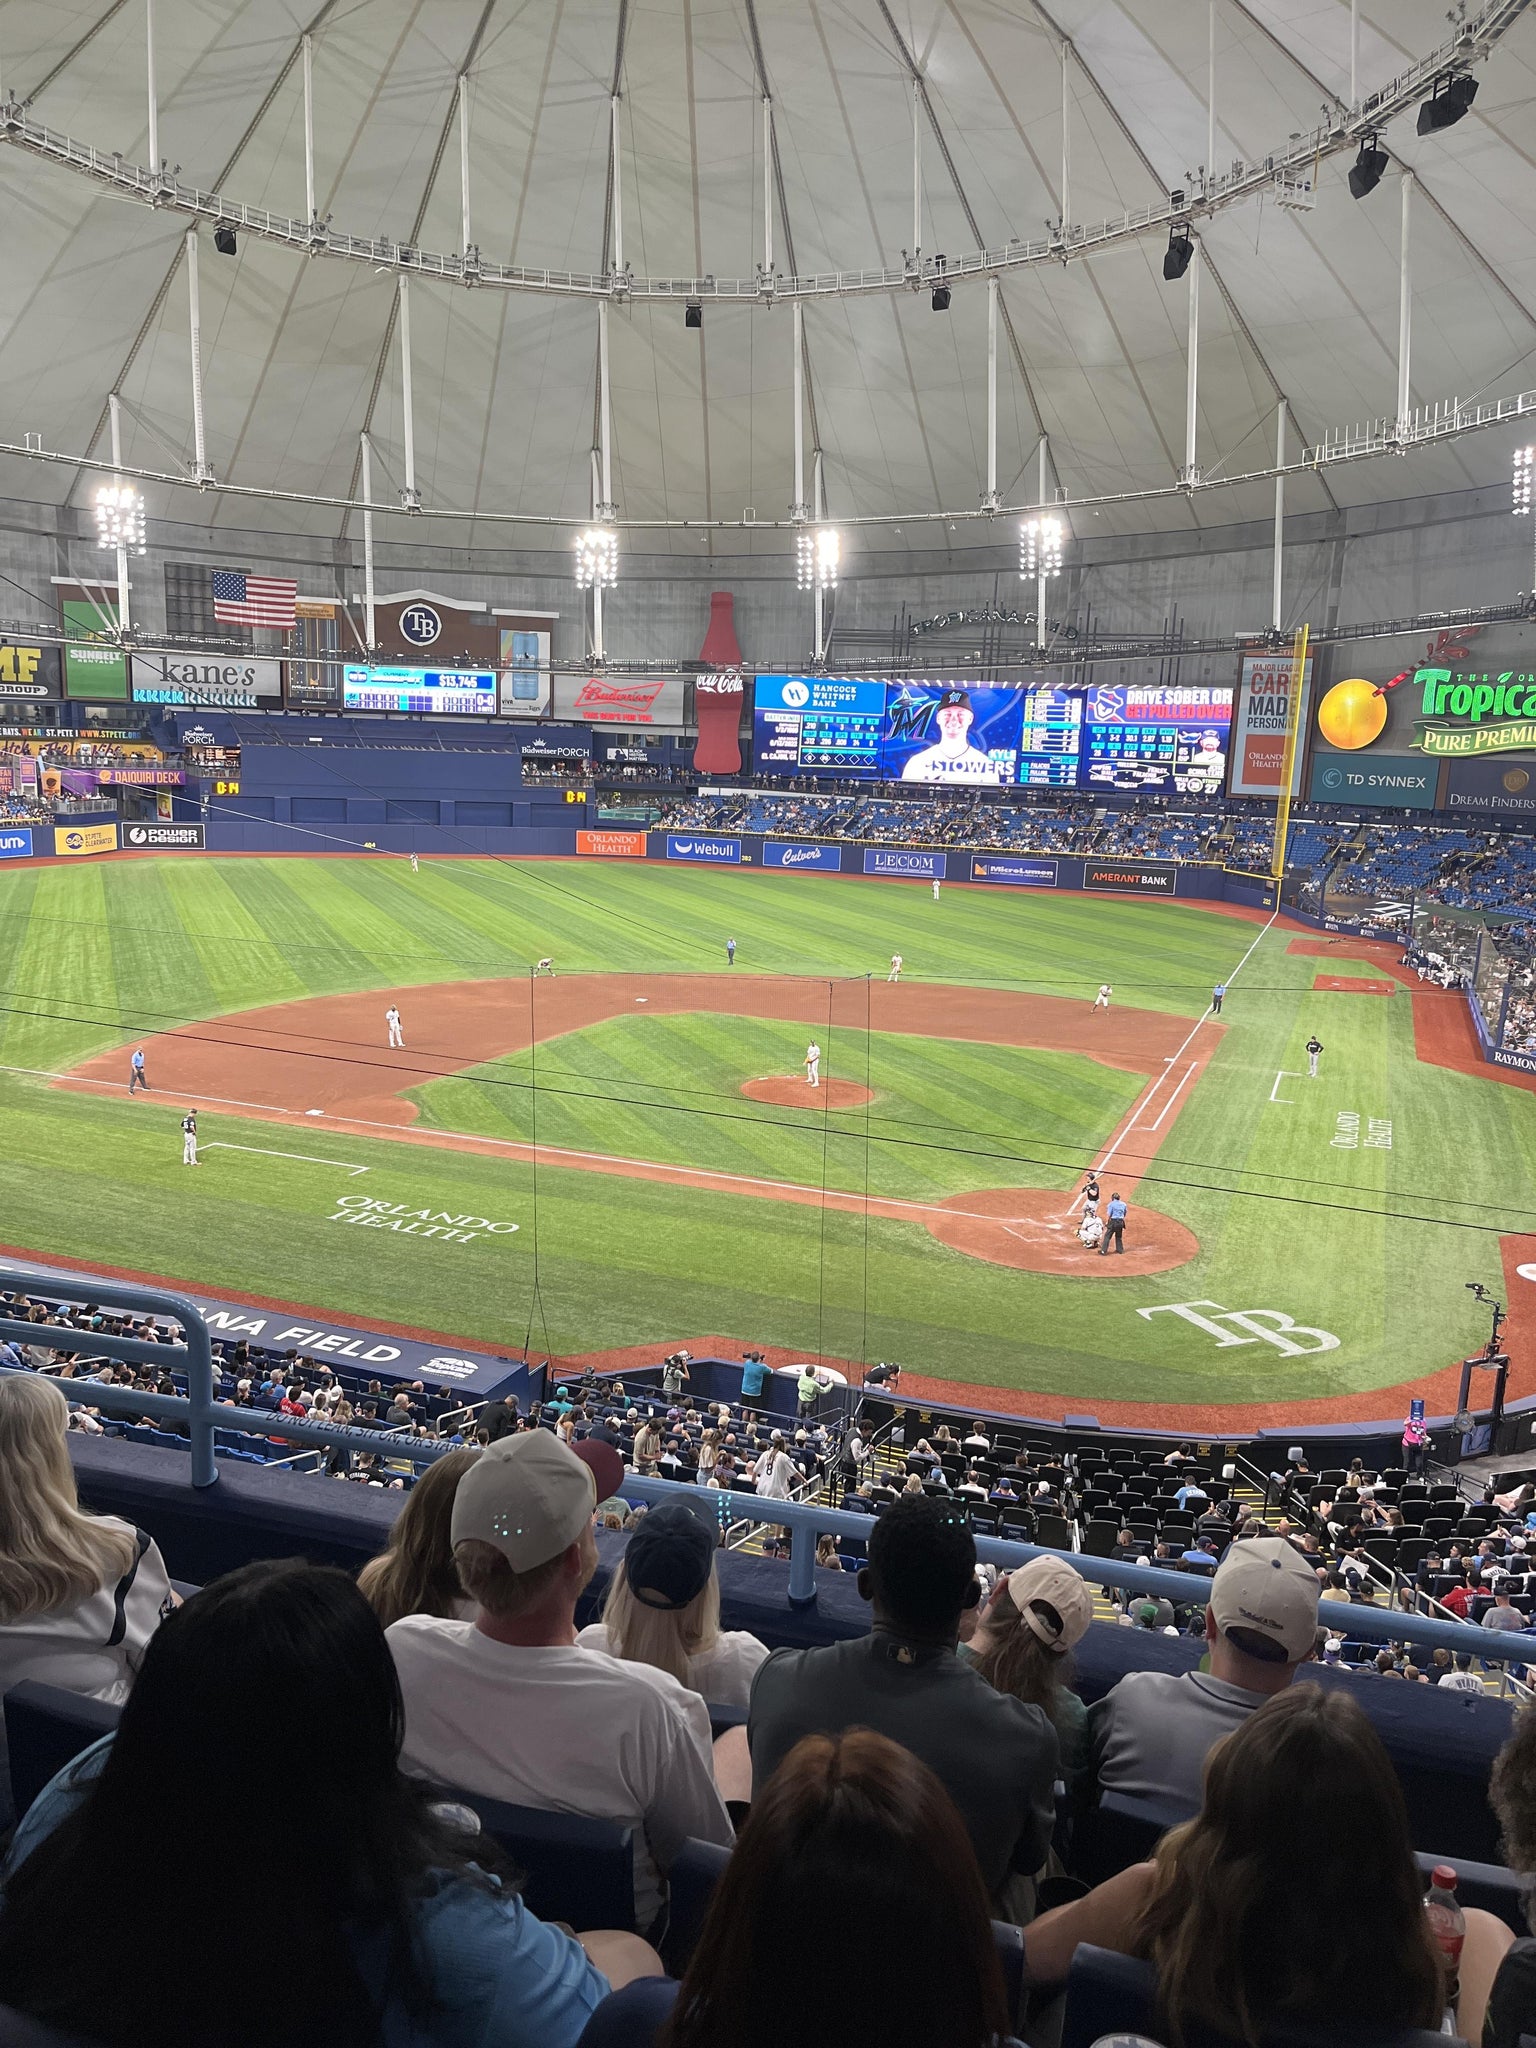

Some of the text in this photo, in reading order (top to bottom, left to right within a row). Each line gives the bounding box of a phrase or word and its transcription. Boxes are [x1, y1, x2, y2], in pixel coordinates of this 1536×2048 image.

[408, 611, 434, 638] TB
[70, 649, 122, 660] SUNBELT
[159, 656, 256, 686] kane's
[1252, 664, 1301, 673] MAJOR LEAGU
[438, 674, 478, 688] $13,745
[1250, 672, 1300, 696] CARE
[1456, 674, 1536, 682] THE OR
[814, 684, 856, 693] HANCOCK
[812, 692, 856, 700] WHITNEY
[1126, 690, 1233, 704] DRIVE SOBER OR
[1125, 704, 1232, 720] GET PULLED OVER
[1248, 696, 1300, 717] MADE
[583, 710, 600, 720] THIS
[624, 712, 636, 722] FOR
[182, 736, 215, 744] PORCH
[1424, 730, 1470, 750] PURE
[521, 745, 590, 757] Budweiser PORCH
[989, 750, 1016, 762] KYLE
[1248, 752, 1288, 760] ORLANDO
[932, 760, 1016, 776] STOWERS
[1252, 760, 1283, 768] HEALTH
[115, 772, 180, 784] DAIQUIRI DECK
[1347, 774, 1426, 789] TD SYNNEX
[216, 782, 240, 794] 0:14
[1176, 782, 1186, 792] 12
[1204, 784, 1218, 794] 27
[566, 790, 586, 803] 0:14
[1450, 794, 1536, 808] DREAM FINDERS
[86, 838, 112, 848] CLEARWATER
[586, 833, 637, 846] ORLANDO
[592, 844, 632, 854] HEALTH
[694, 842, 734, 857] Webull
[782, 849, 822, 865] Culver's
[990, 866, 1054, 876] MicroLumen
[1092, 872, 1168, 886] AMERANT BANK
[1330, 1111, 1361, 1150] ORLANDO
[1364, 1117, 1392, 1150] HEALTH
[336, 1196, 520, 1234] ORLANDO
[326, 1208, 482, 1244] HEALTH
[1136, 1300, 1341, 1358] TB
[273, 1326, 402, 1362] FIELD
[266, 1413, 286, 1423] DO
[290, 1415, 314, 1426] NOT
[317, 1421, 352, 1436] LEAN,
[356, 1428, 374, 1438] SIT
[378, 1432, 400, 1445] ON,
[404, 1436, 422, 1446] OR
